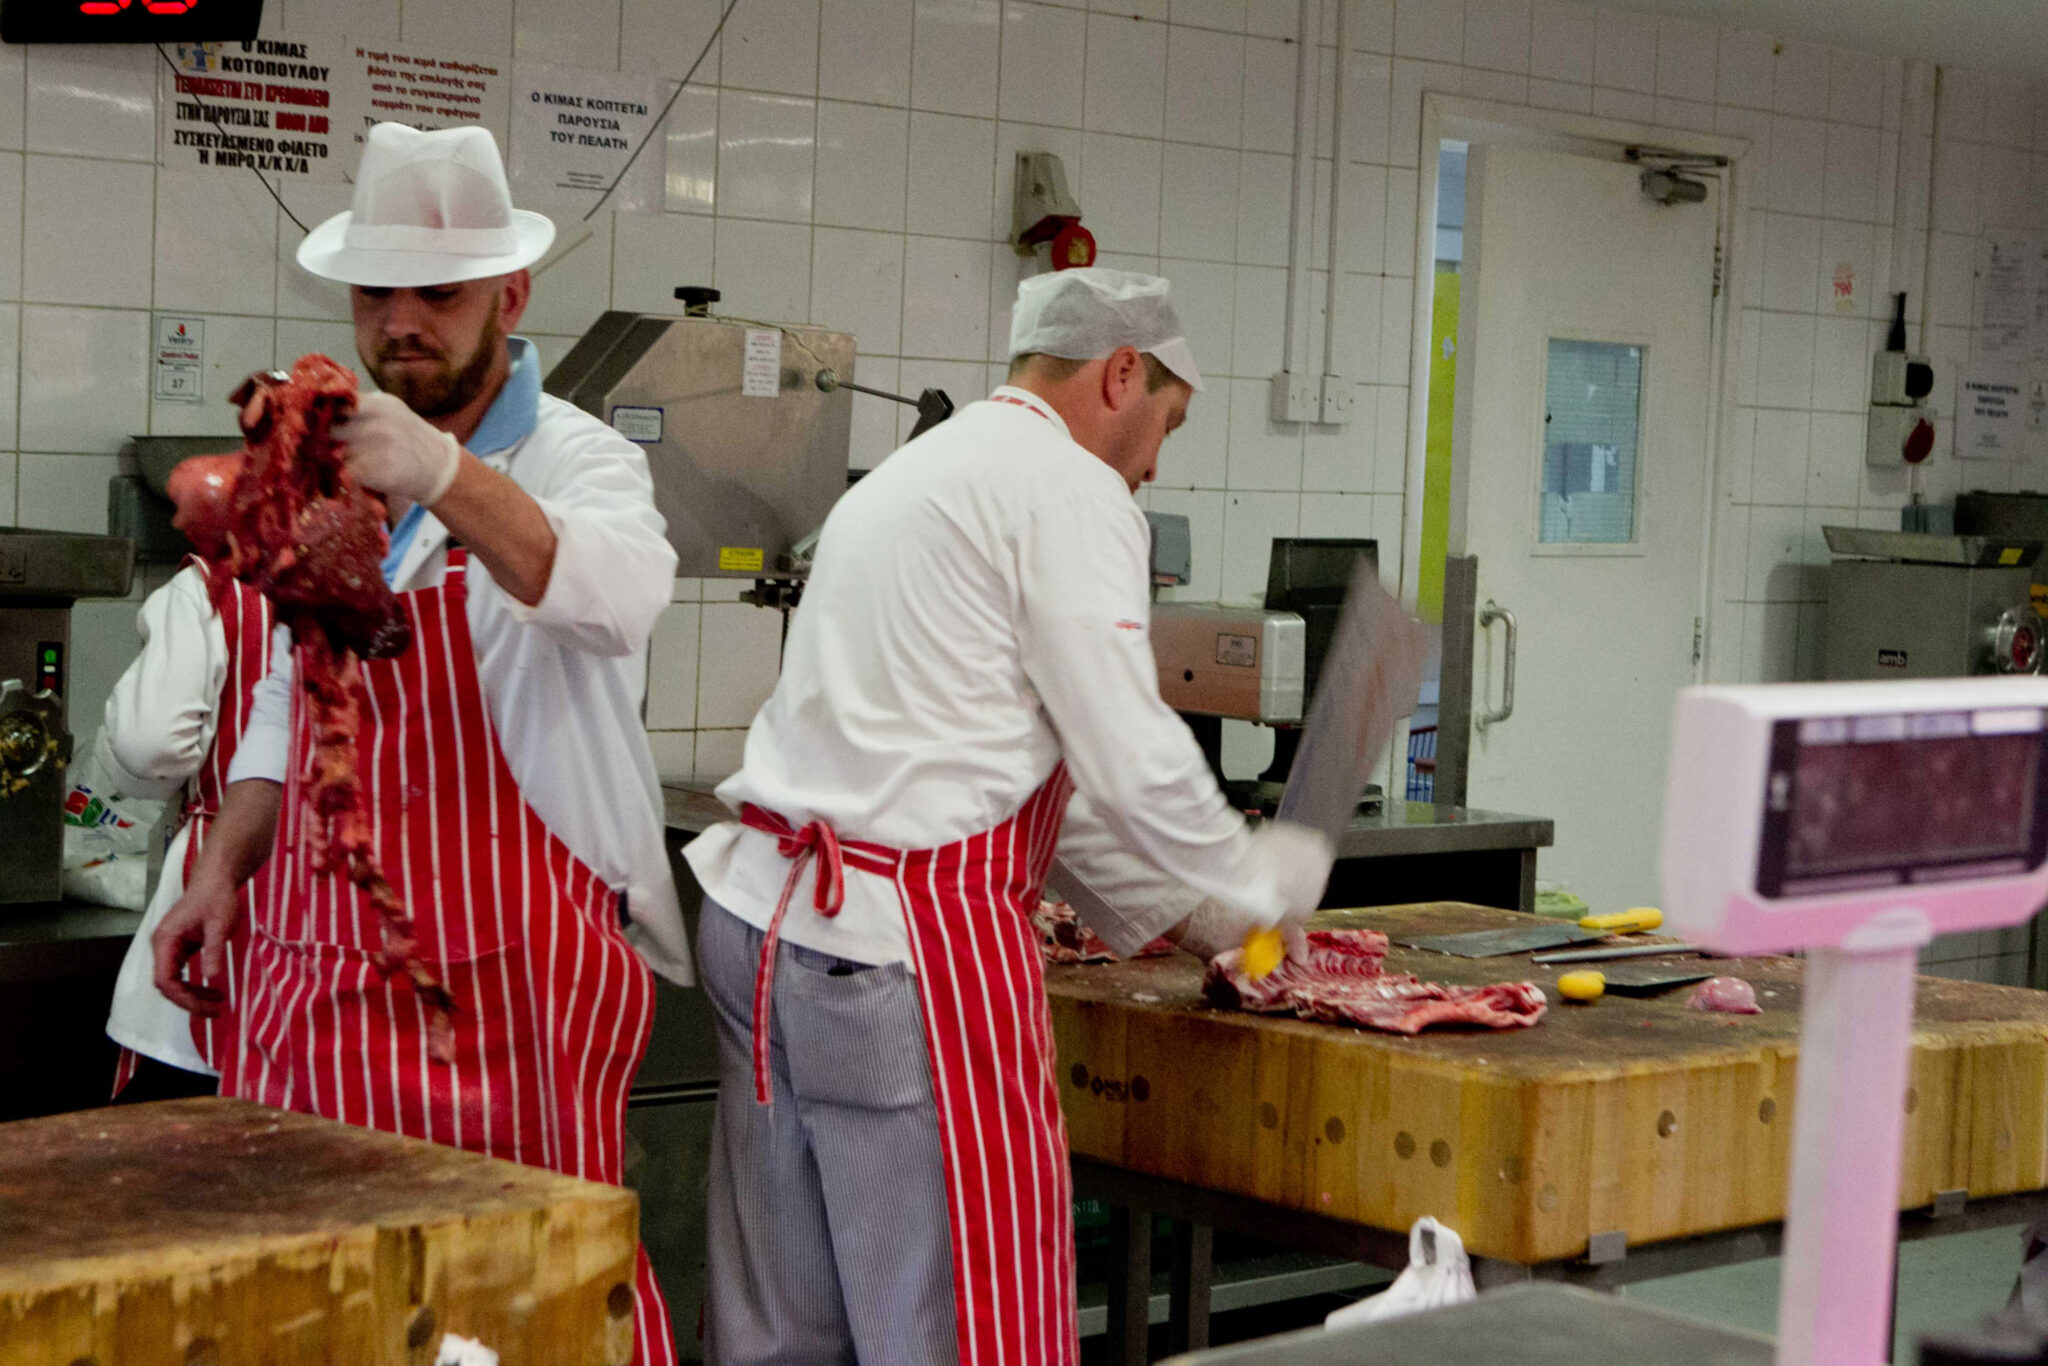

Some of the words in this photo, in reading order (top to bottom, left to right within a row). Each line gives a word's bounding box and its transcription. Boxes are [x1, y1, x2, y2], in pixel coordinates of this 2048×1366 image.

[257, 40, 308, 58] ΚΙΜΑΣ
[222, 56, 330, 82] ΚΟΤΟΠΟΥΛΟΥ
[531, 91, 541, 103] Ο
[544, 93, 583, 109] ΚΙΜΑΣ
[586, 98, 648, 116] ΚΟΠΤΕΤΑΙ
[202, 104, 251, 126] ΠΑΡΟΥΣΙΑ
[253, 109, 270, 129] ΣΑΣ
[558, 113, 620, 131] ΠΑΡΟΥΣΙΑ
[174, 130, 274, 154] ΣΥΣΚΕΥΑΣΜΕΝΟ
[277, 140, 329, 158] ΦΙΛΕΤΟ
[550, 131, 575, 145] ΤΟΥ
[578, 135, 628, 150] ΠΕΛΑΤΗ
